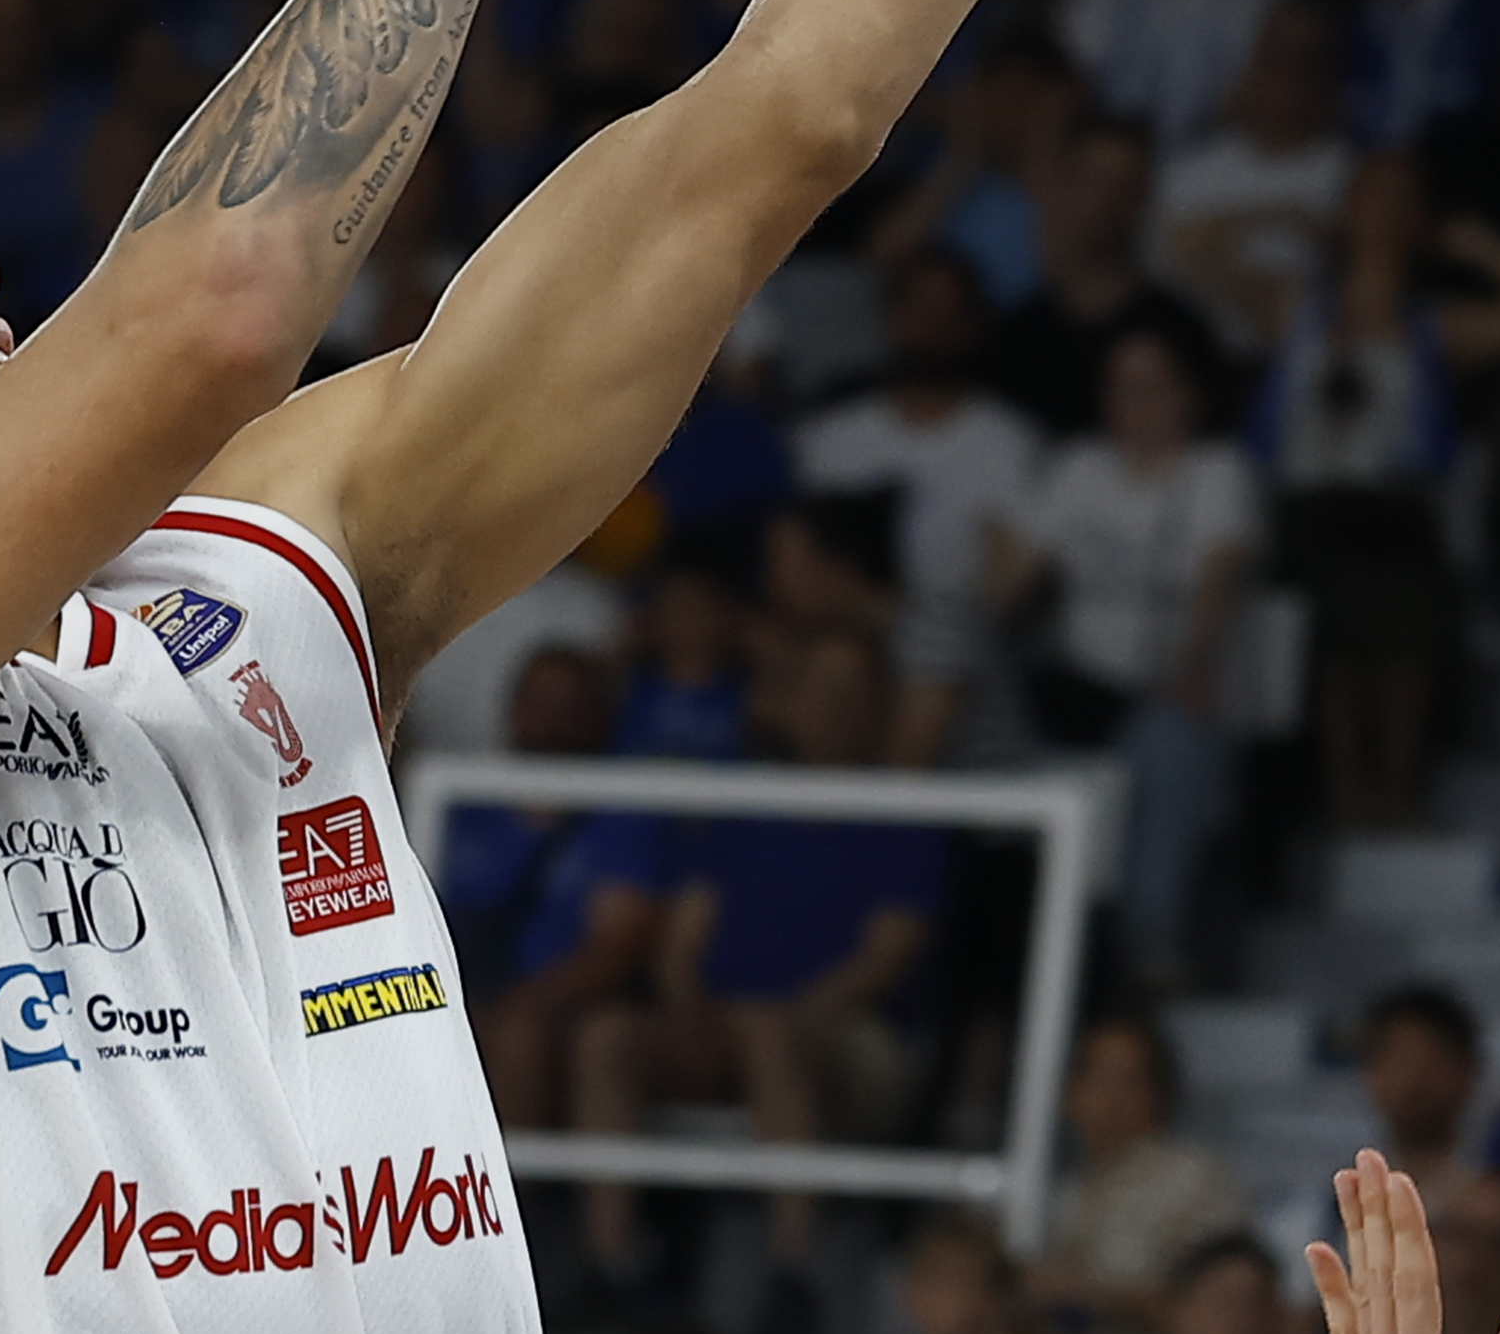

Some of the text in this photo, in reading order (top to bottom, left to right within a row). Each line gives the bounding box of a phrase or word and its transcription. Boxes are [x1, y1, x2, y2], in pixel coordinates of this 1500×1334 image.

[333, 56, 450, 245] Guidance from
[178, 614, 231, 660] Unipol
[287, 879, 391, 923] EYEWEAR
[86, 994, 191, 1044] Group
